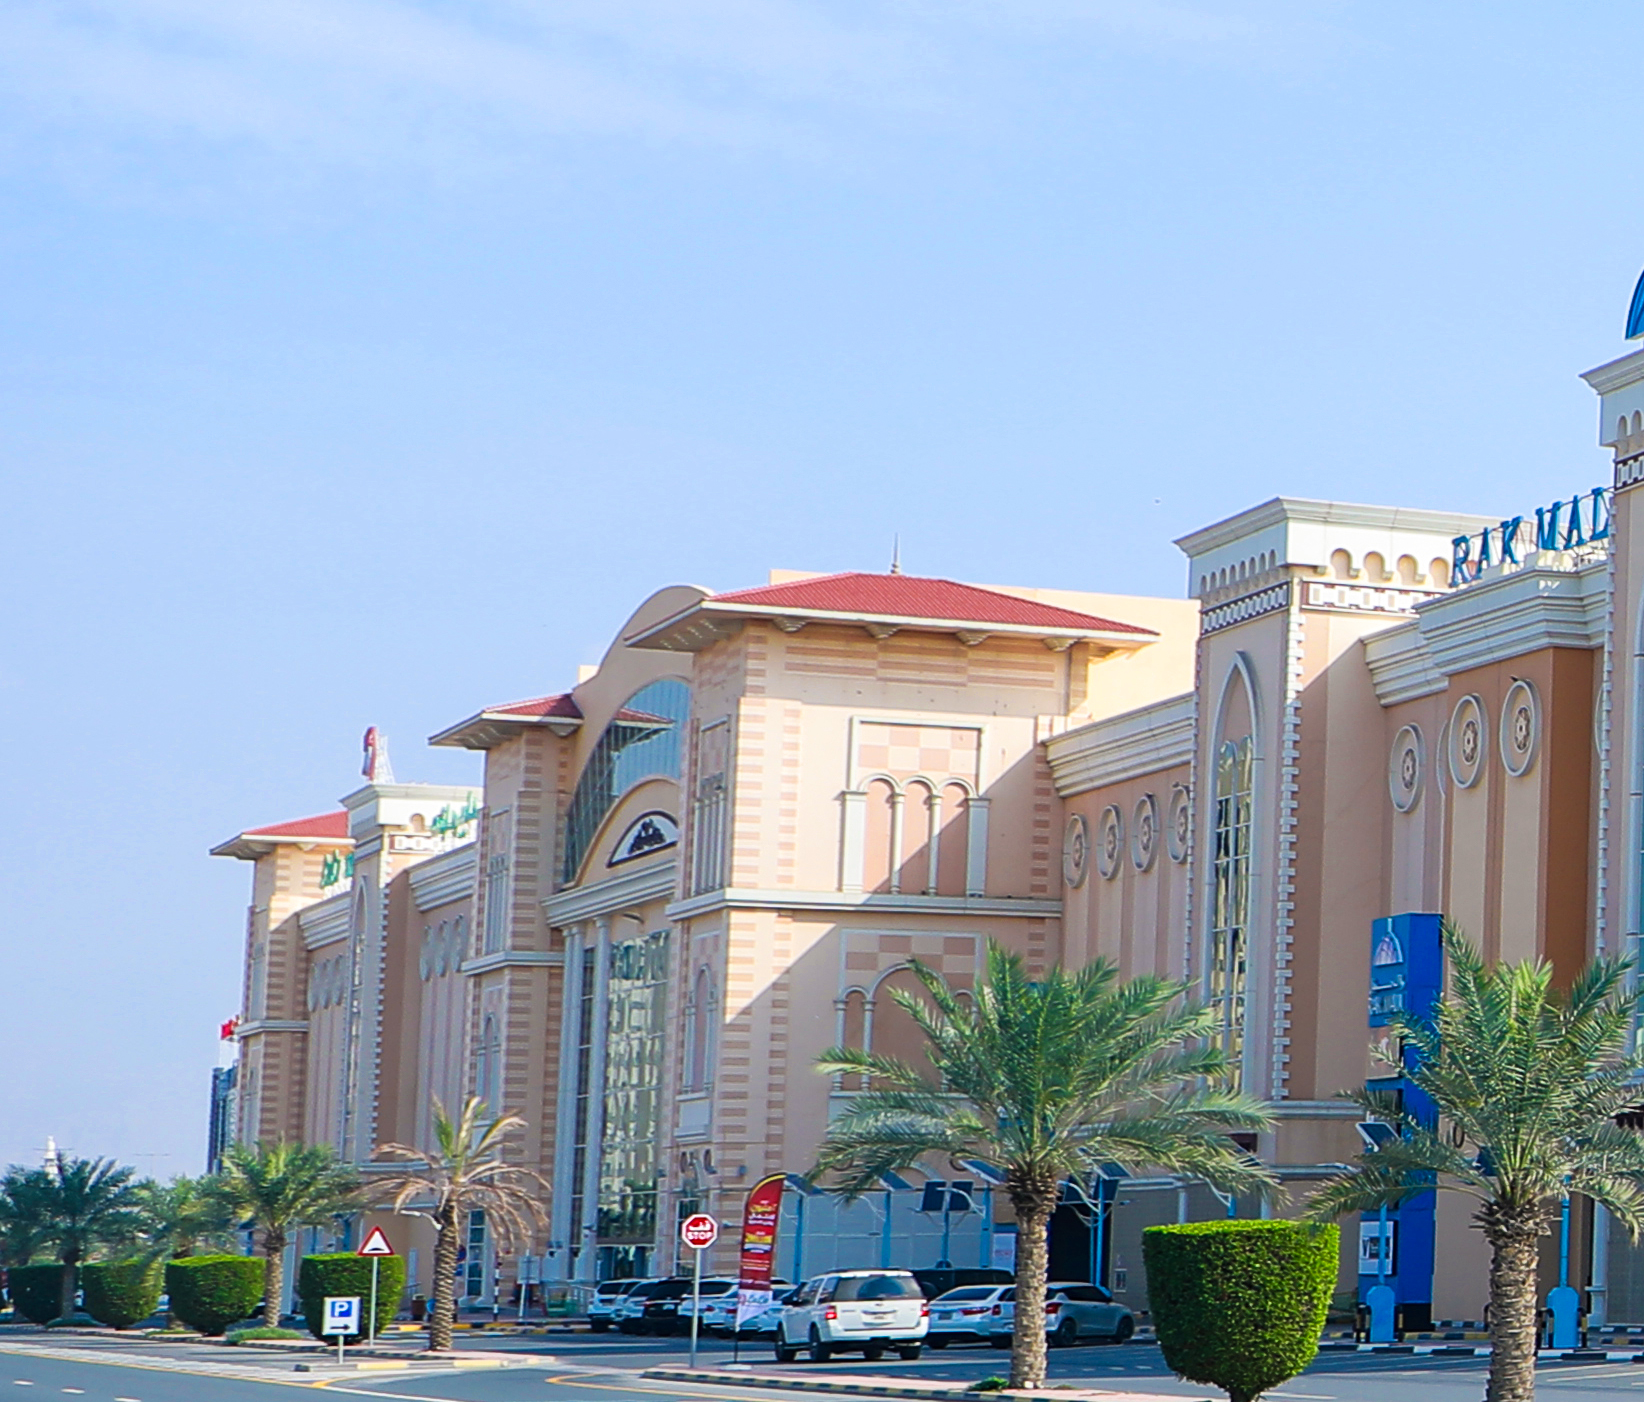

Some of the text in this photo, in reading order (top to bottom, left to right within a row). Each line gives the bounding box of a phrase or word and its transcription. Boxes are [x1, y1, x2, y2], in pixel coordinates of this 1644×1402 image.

[1449, 515, 1526, 588] RAK
[687, 1220, 713, 1232] قف
[686, 1231, 713, 1241] STOP
[334, 1301, 349, 1317] P
